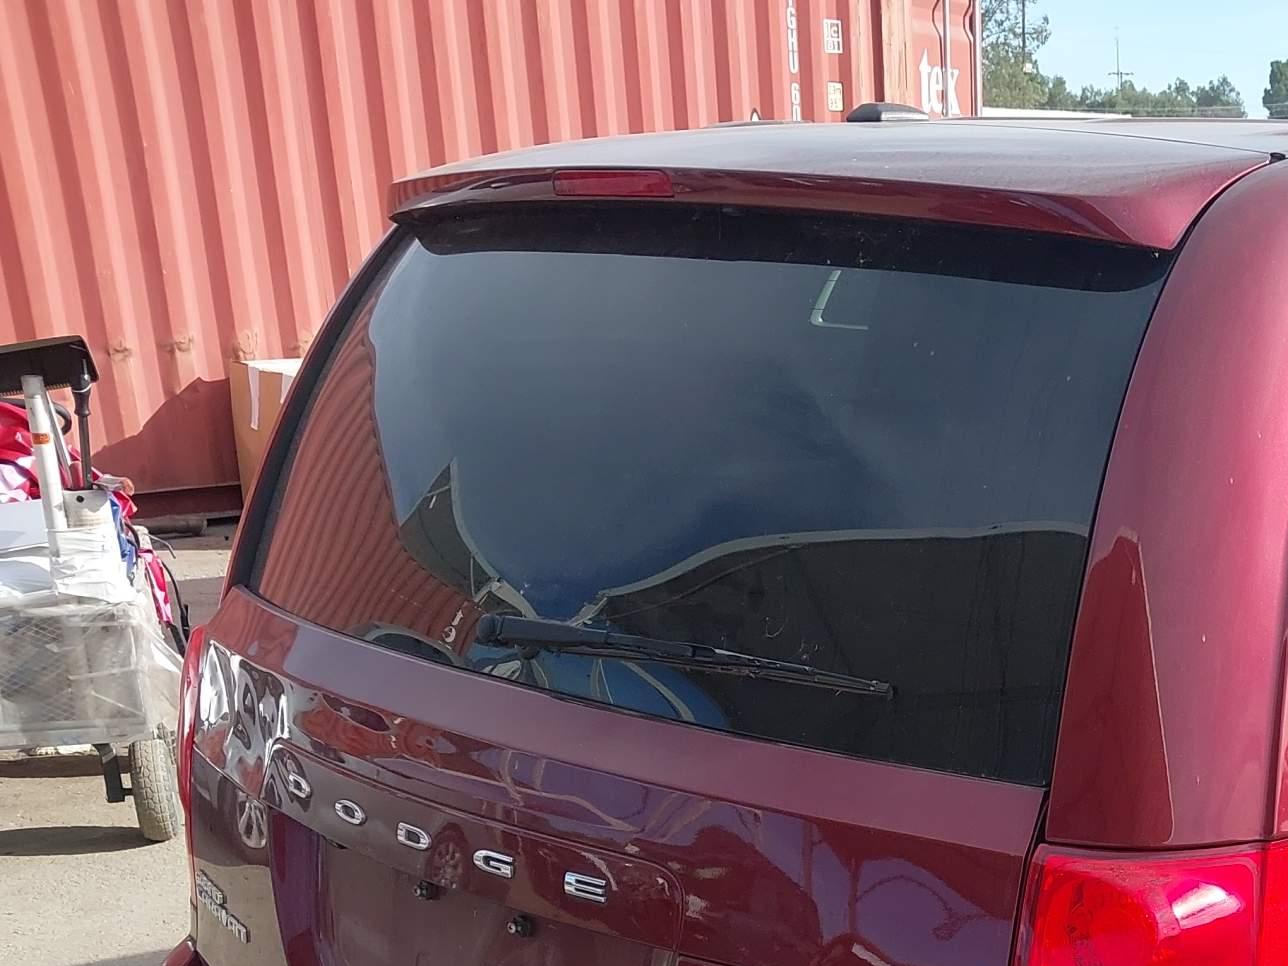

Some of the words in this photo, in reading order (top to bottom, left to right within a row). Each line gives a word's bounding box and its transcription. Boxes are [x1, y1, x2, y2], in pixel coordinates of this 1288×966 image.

[786, 0, 799, 73] GHU
[918, 48, 960, 115] tex
[288, 773, 606, 903] DODGE
